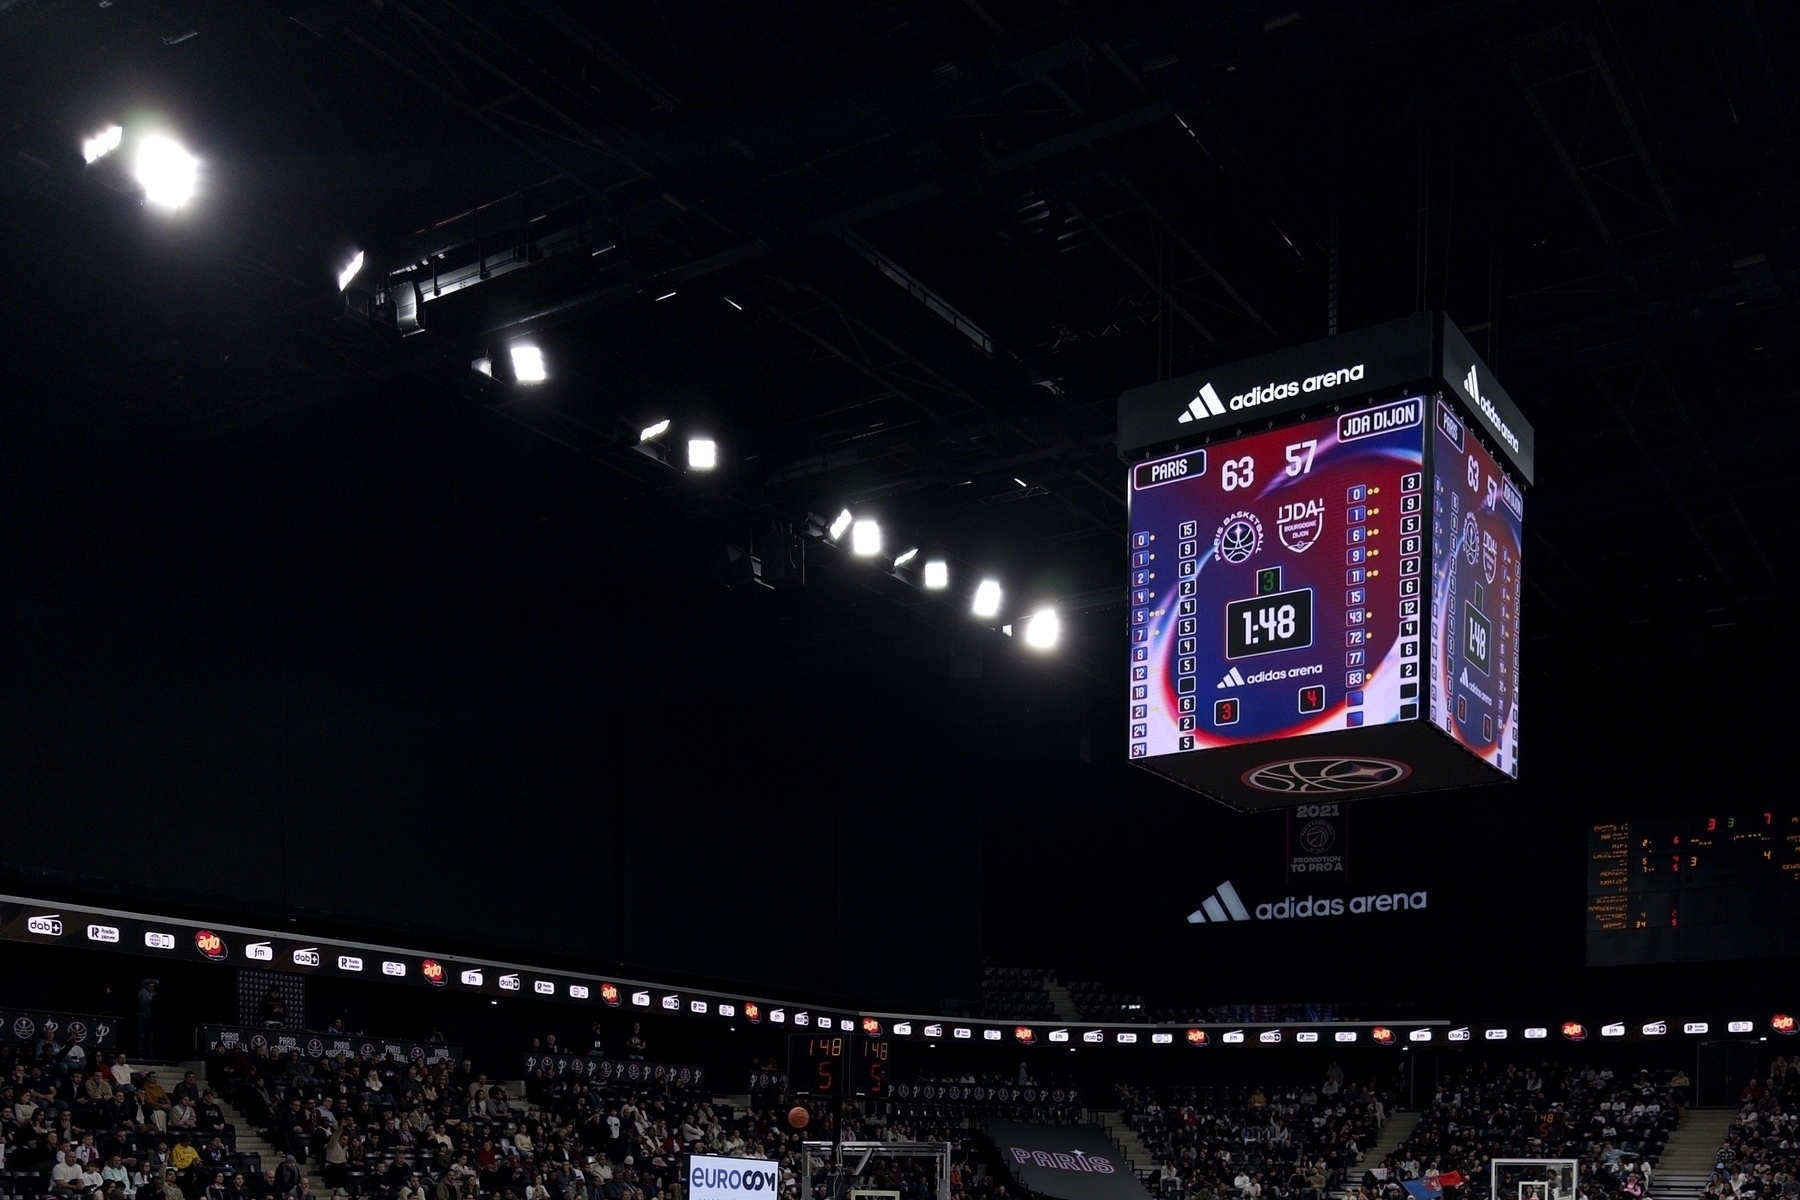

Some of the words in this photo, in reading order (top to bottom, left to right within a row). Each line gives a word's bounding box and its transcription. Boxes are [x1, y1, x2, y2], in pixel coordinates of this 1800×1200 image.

[1229, 378, 1299, 411] adidas
[1302, 364, 1364, 394] arena
[1343, 414, 1371, 437] JDA
[1373, 404, 1415, 431] DIJON
[1443, 412, 1458, 441] PARIS
[1480, 396, 1501, 432] adidas
[1501, 422, 1519, 454] arena
[1285, 439, 1318, 477] 57
[1151, 458, 1187, 482] PARIS
[1221, 456, 1254, 492] 63
[1467, 454, 1479, 493] 63
[1407, 477, 1415, 489] 3
[1353, 488, 1360, 500] 0
[1487, 474, 1497, 512] 57
[1407, 498, 1414, 510] 9
[1354, 509, 1359, 521] 1
[1183, 524, 1192, 535] 15
[1284, 520, 1317, 533] BOURGOGNE
[1407, 519, 1414, 531] 5
[1223, 510, 1266, 554] BASKETBALL
[1292, 529, 1309, 539] DIJON
[1353, 530, 1360, 541] 6
[1138, 535, 1145, 546] 0
[1406, 540, 1414, 552] 8
[1184, 543, 1191, 554] 9
[1138, 554, 1143, 565] 1
[1352, 551, 1359, 562] 9
[1184, 563, 1191, 574] 6
[1406, 560, 1414, 573] 2
[1137, 573, 1144, 584] 2
[1263, 571, 1274, 592] 3
[1352, 571, 1360, 583] 11
[1184, 583, 1191, 594] 2
[1406, 581, 1413, 594] 6
[1137, 592, 1144, 603] 4
[1350, 591, 1361, 603] 15
[1184, 602, 1191, 613] 4
[1404, 602, 1415, 615] 12
[1137, 611, 1144, 621] 5
[1349, 612, 1362, 624] 43
[1184, 622, 1190, 632] 5
[1242, 604, 1296, 645] 1:48
[1406, 623, 1413, 635] 4
[1137, 630, 1144, 640] 7
[1349, 632, 1362, 644] 72
[1469, 616, 1486, 661] 1:48
[1184, 640, 1190, 651] 4
[1405, 644, 1412, 656] 6
[1137, 649, 1144, 660] 8
[1349, 653, 1362, 665] 77
[1184, 660, 1190, 671] 5
[1405, 664, 1412, 676] 2
[1135, 668, 1145, 679] 12
[1246, 669, 1286, 685] adidas
[1288, 664, 1323, 678] arena
[1349, 673, 1362, 685] 83
[1135, 687, 1145, 698] 18
[1307, 690, 1317, 707] 4
[1183, 699, 1190, 710] 6
[1135, 706, 1145, 717] 21
[1222, 703, 1232, 720] 3
[1183, 718, 1190, 729] 2
[1134, 726, 1146, 736] 24
[1183, 738, 1190, 749] 5
[1133, 745, 1145, 755] 34
[1296, 804, 1340, 818] 2021
[1293, 856, 1341, 864] PROMOTION
[1290, 863, 1307, 873] TO
[1308, 862, 1333, 872] PRO
[1333, 862, 1343, 871] A
[1255, 894, 1344, 920] adidas
[1349, 890, 1427, 913] arena
[221, 1032, 239, 1042] PARIS
[279, 1036, 297, 1046] PARIS
[334, 1041, 350, 1051] PARIS
[385, 1045, 401, 1054] PARIS
